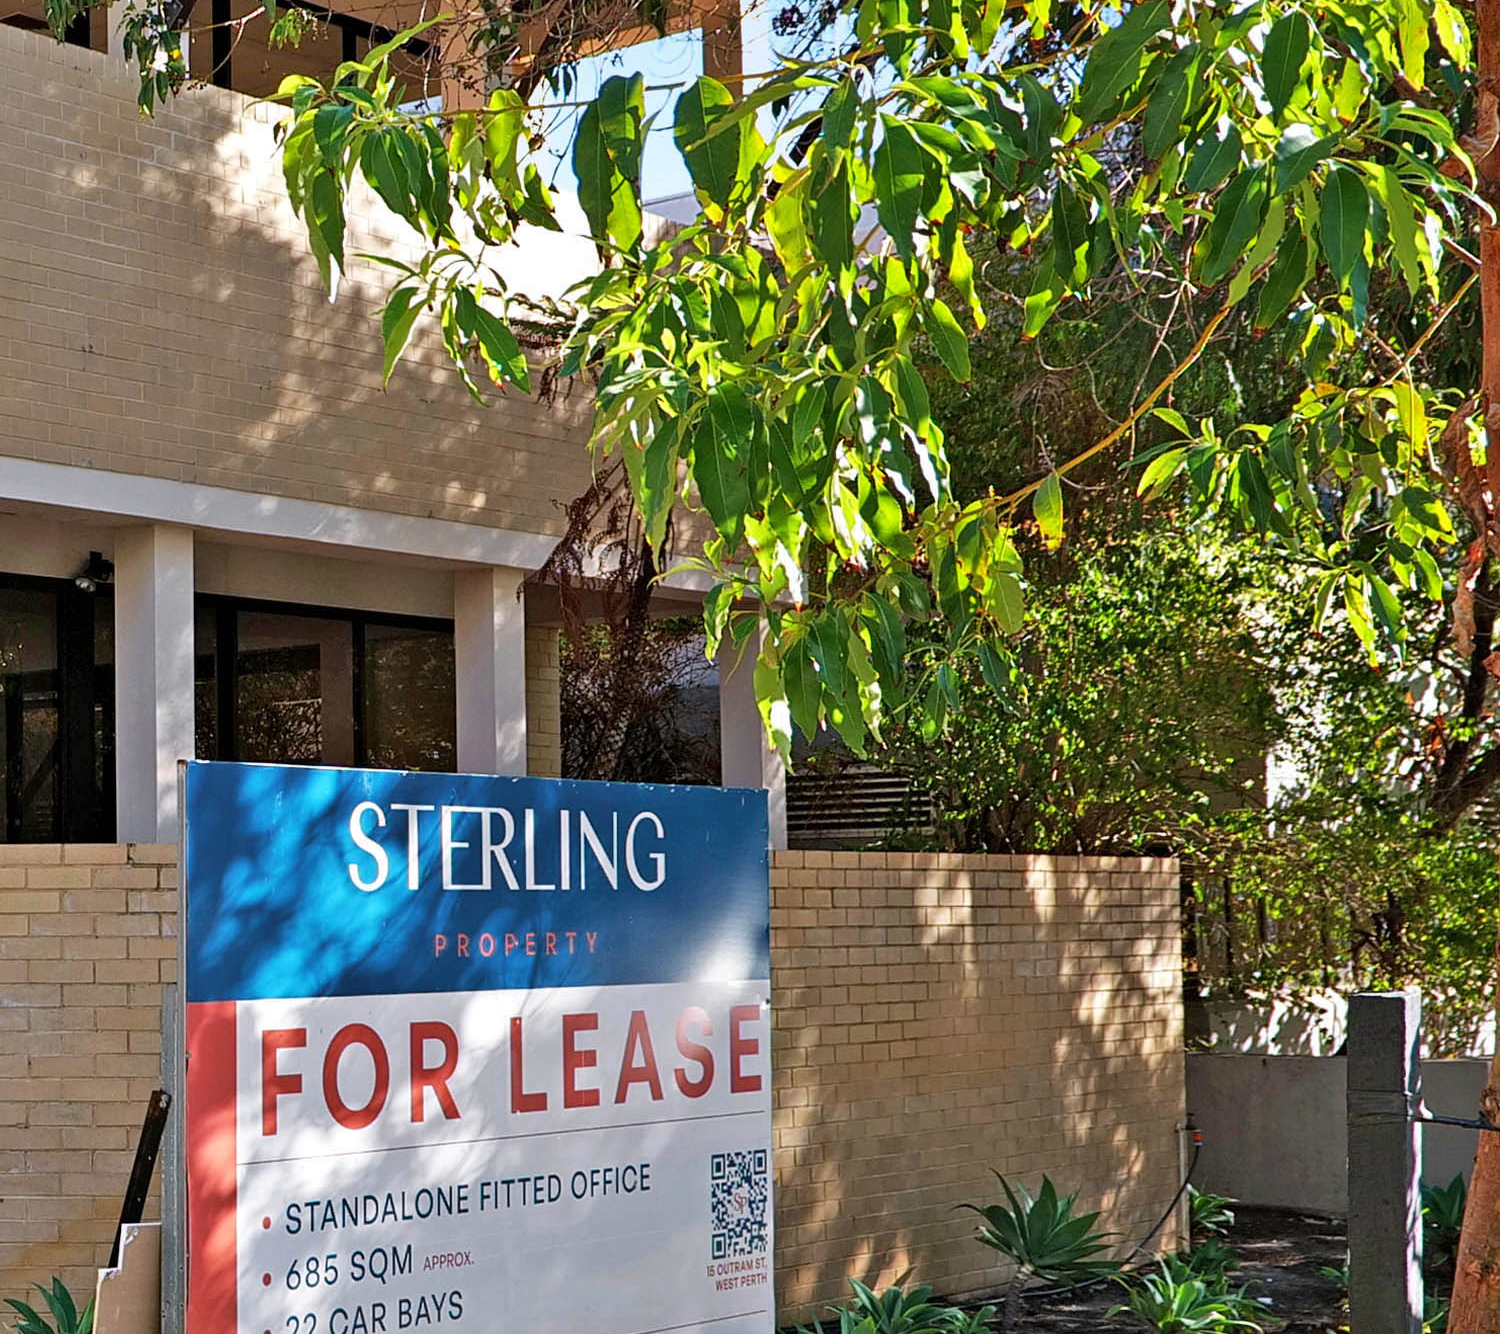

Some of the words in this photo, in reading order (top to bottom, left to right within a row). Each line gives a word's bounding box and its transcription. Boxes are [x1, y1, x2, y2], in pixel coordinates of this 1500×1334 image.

[348, 800, 666, 892] STERLING
[435, 932, 600, 958] PROPERTY
[261, 1020, 463, 1137] FOR
[510, 1003, 763, 1115] LEASE
[285, 1184, 470, 1236] STANDALONE
[479, 1173, 562, 1213] FITTED
[570, 1163, 652, 1200] OFFICE
[285, 1253, 340, 1291] 685
[350, 1243, 414, 1285] SQM
[423, 1251, 475, 1272] APPROX.
[707, 1265, 716, 1277] 15
[716, 1258, 754, 1276] OUTRAM
[755, 1256, 768, 1269] ST.
[715, 1276, 739, 1292] WEST
[741, 1272, 768, 1287] PERTH
[398, 1290, 464, 1330] BAYS
